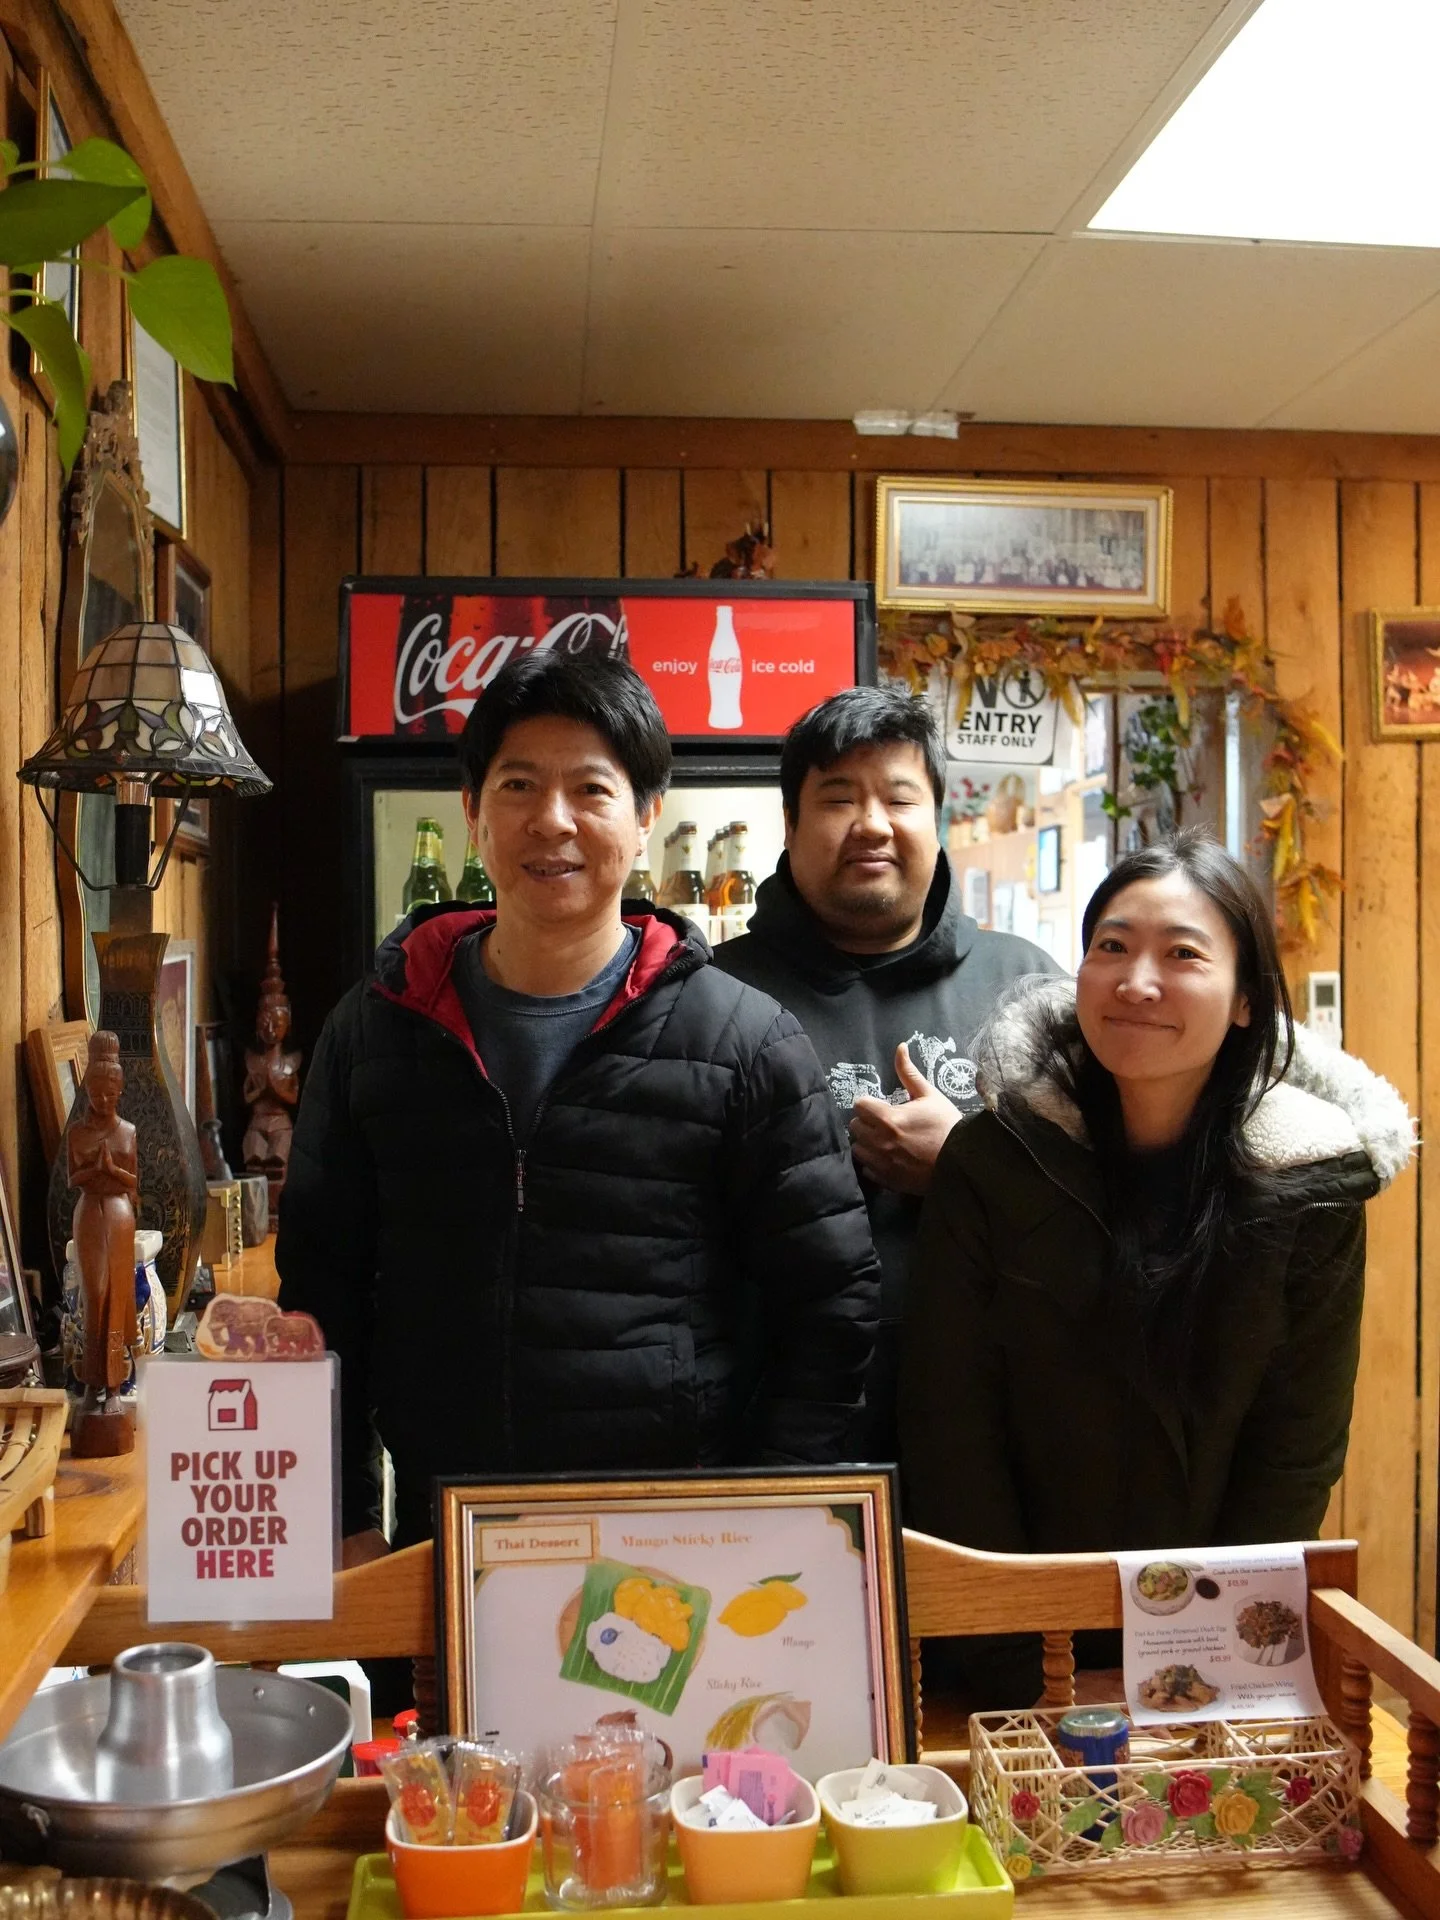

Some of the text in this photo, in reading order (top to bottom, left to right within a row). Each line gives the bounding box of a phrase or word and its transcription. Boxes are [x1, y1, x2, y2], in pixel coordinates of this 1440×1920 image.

[652, 658, 698, 675] enjoy
[752, 659, 775, 673] ice
[779, 659, 815, 673] cold
[959, 711, 1042, 734] ENTRY
[957, 733, 1036, 748] STAFF ONLY
[171, 1450, 297, 1481] PICK UP
[190, 1483, 278, 1514] YOUR
[181, 1516, 288, 1547] ORDER
[621, 1532, 752, 1548] Mango Sticky Rice
[494, 1537, 581, 1550] Thai Dessert
[196, 1549, 275, 1579] HERE
[706, 1678, 737, 1692] Sticky
